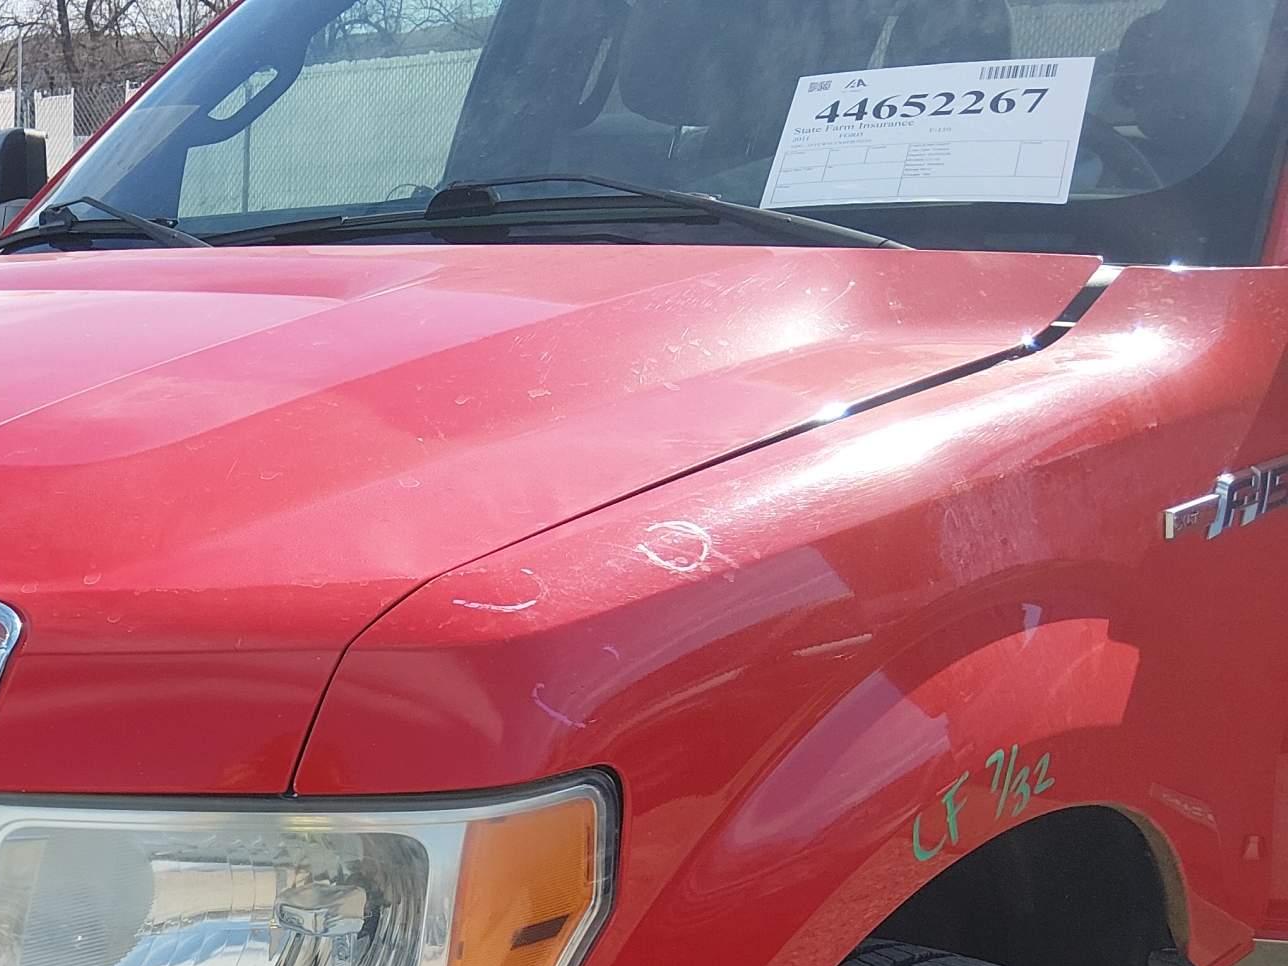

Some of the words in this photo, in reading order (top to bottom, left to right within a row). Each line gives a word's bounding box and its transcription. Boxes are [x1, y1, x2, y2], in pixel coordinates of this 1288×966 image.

[814, 87, 1050, 124] 44652267
[792, 127, 822, 136] State
[825, 123, 855, 133] Farm
[858, 119, 915, 130] Insurance
[984, 742, 1056, 823] 7/32
